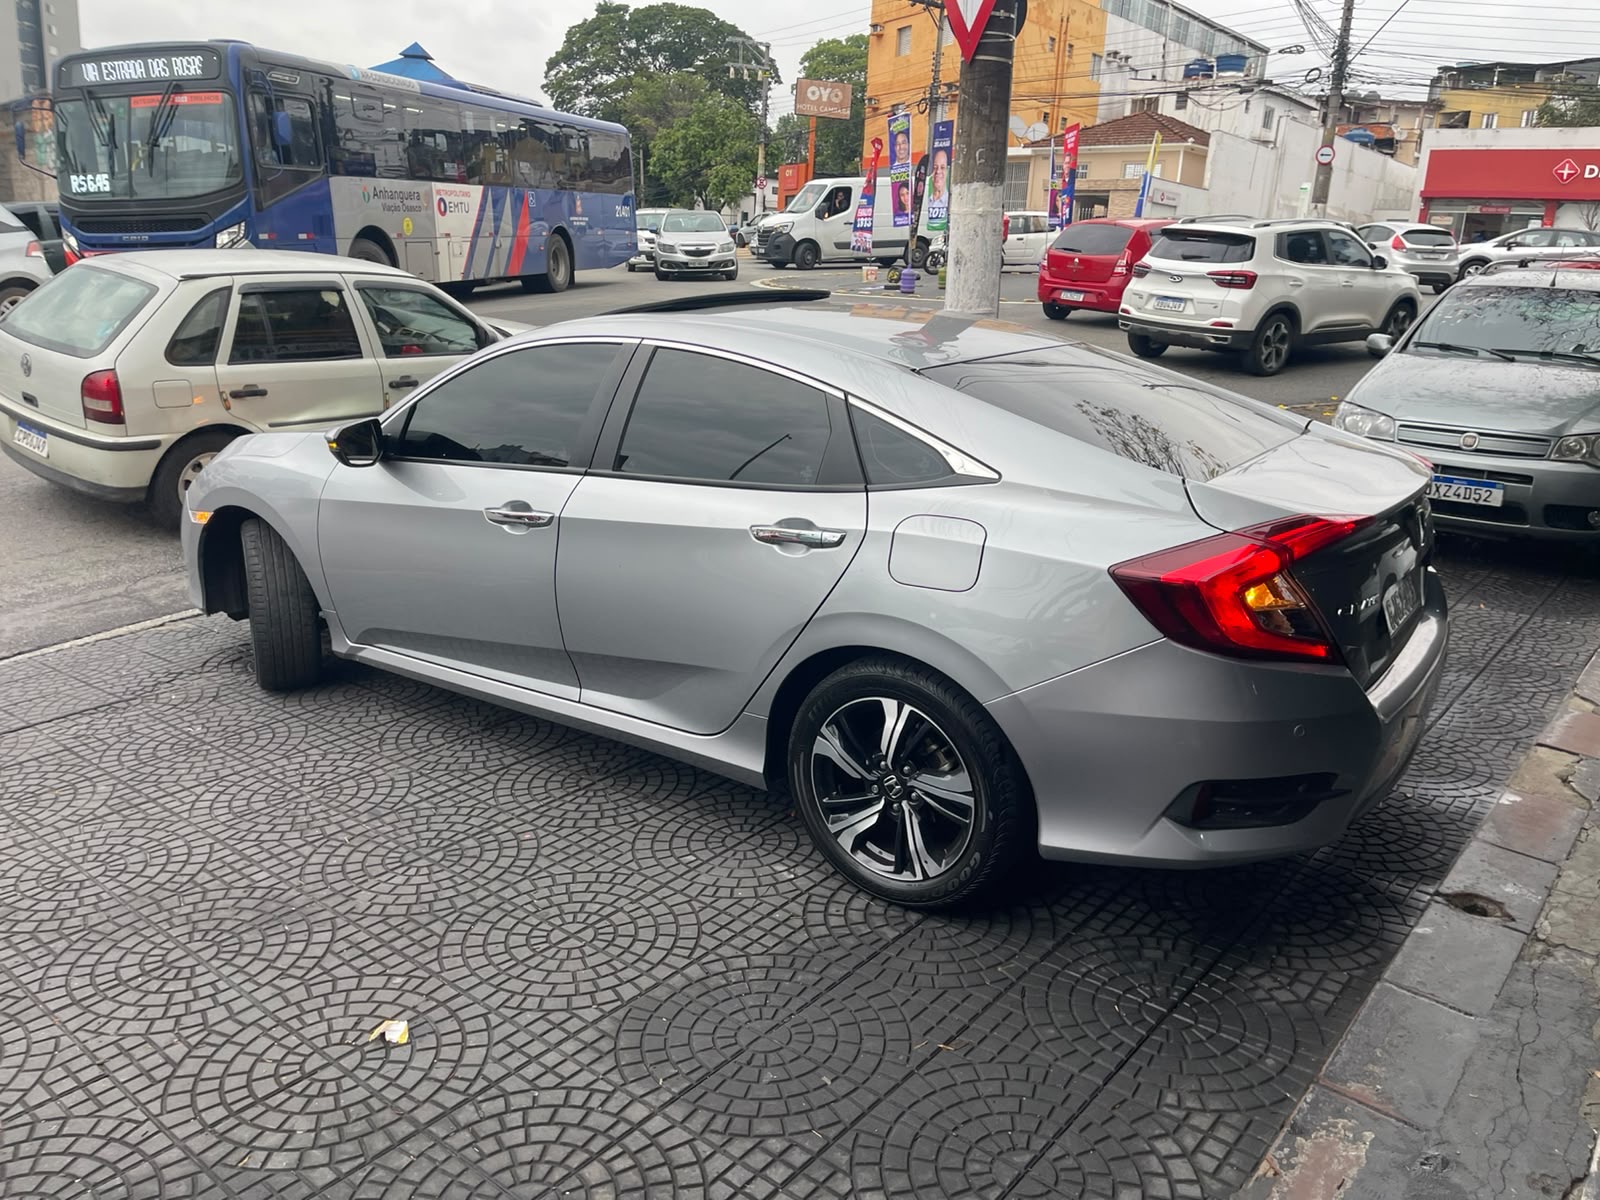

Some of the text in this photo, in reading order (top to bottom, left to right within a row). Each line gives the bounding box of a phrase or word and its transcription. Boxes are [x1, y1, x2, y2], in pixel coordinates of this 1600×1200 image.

[101, 60, 146, 80] ESTRADA
[147, 58, 170, 78] DAS
[806, 85, 843, 103] OYO
[796, 103, 818, 111] HOTEL
[1584, 164, 1600, 179] D
[373, 186, 421, 203] Anhanguera
[435, 189, 471, 198] METROPOLITANO
[381, 203, 422, 214] Viação Osasco
[448, 202, 470, 214] EMTU
